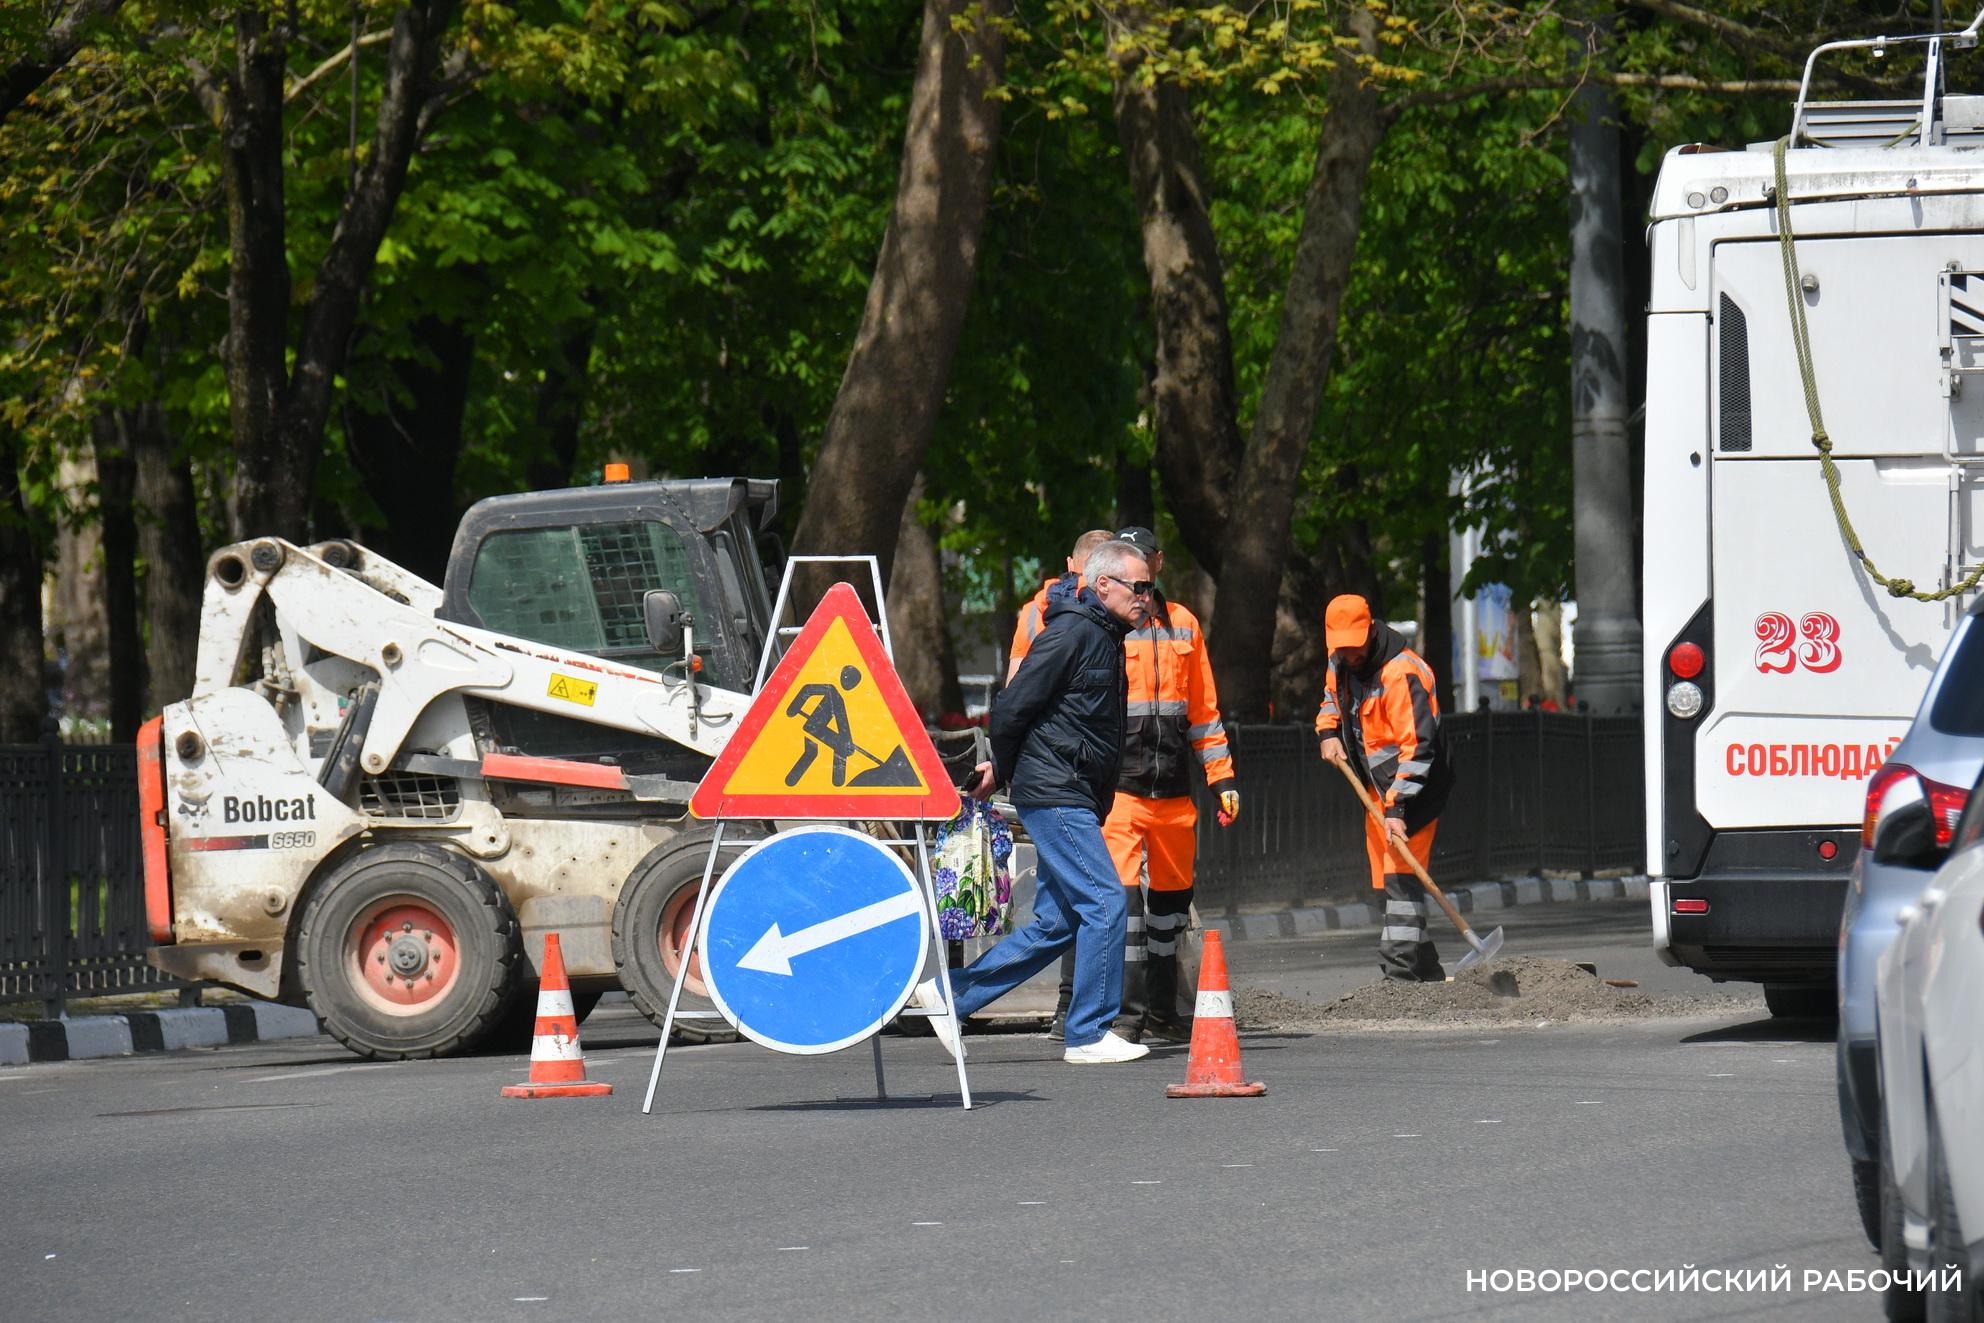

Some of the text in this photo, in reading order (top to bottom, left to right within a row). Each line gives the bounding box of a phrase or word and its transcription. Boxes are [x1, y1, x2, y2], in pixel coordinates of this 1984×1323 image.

[1755, 611, 1842, 674] 23
[224, 793, 316, 823] Bobcat
[272, 831, 316, 849] S650
